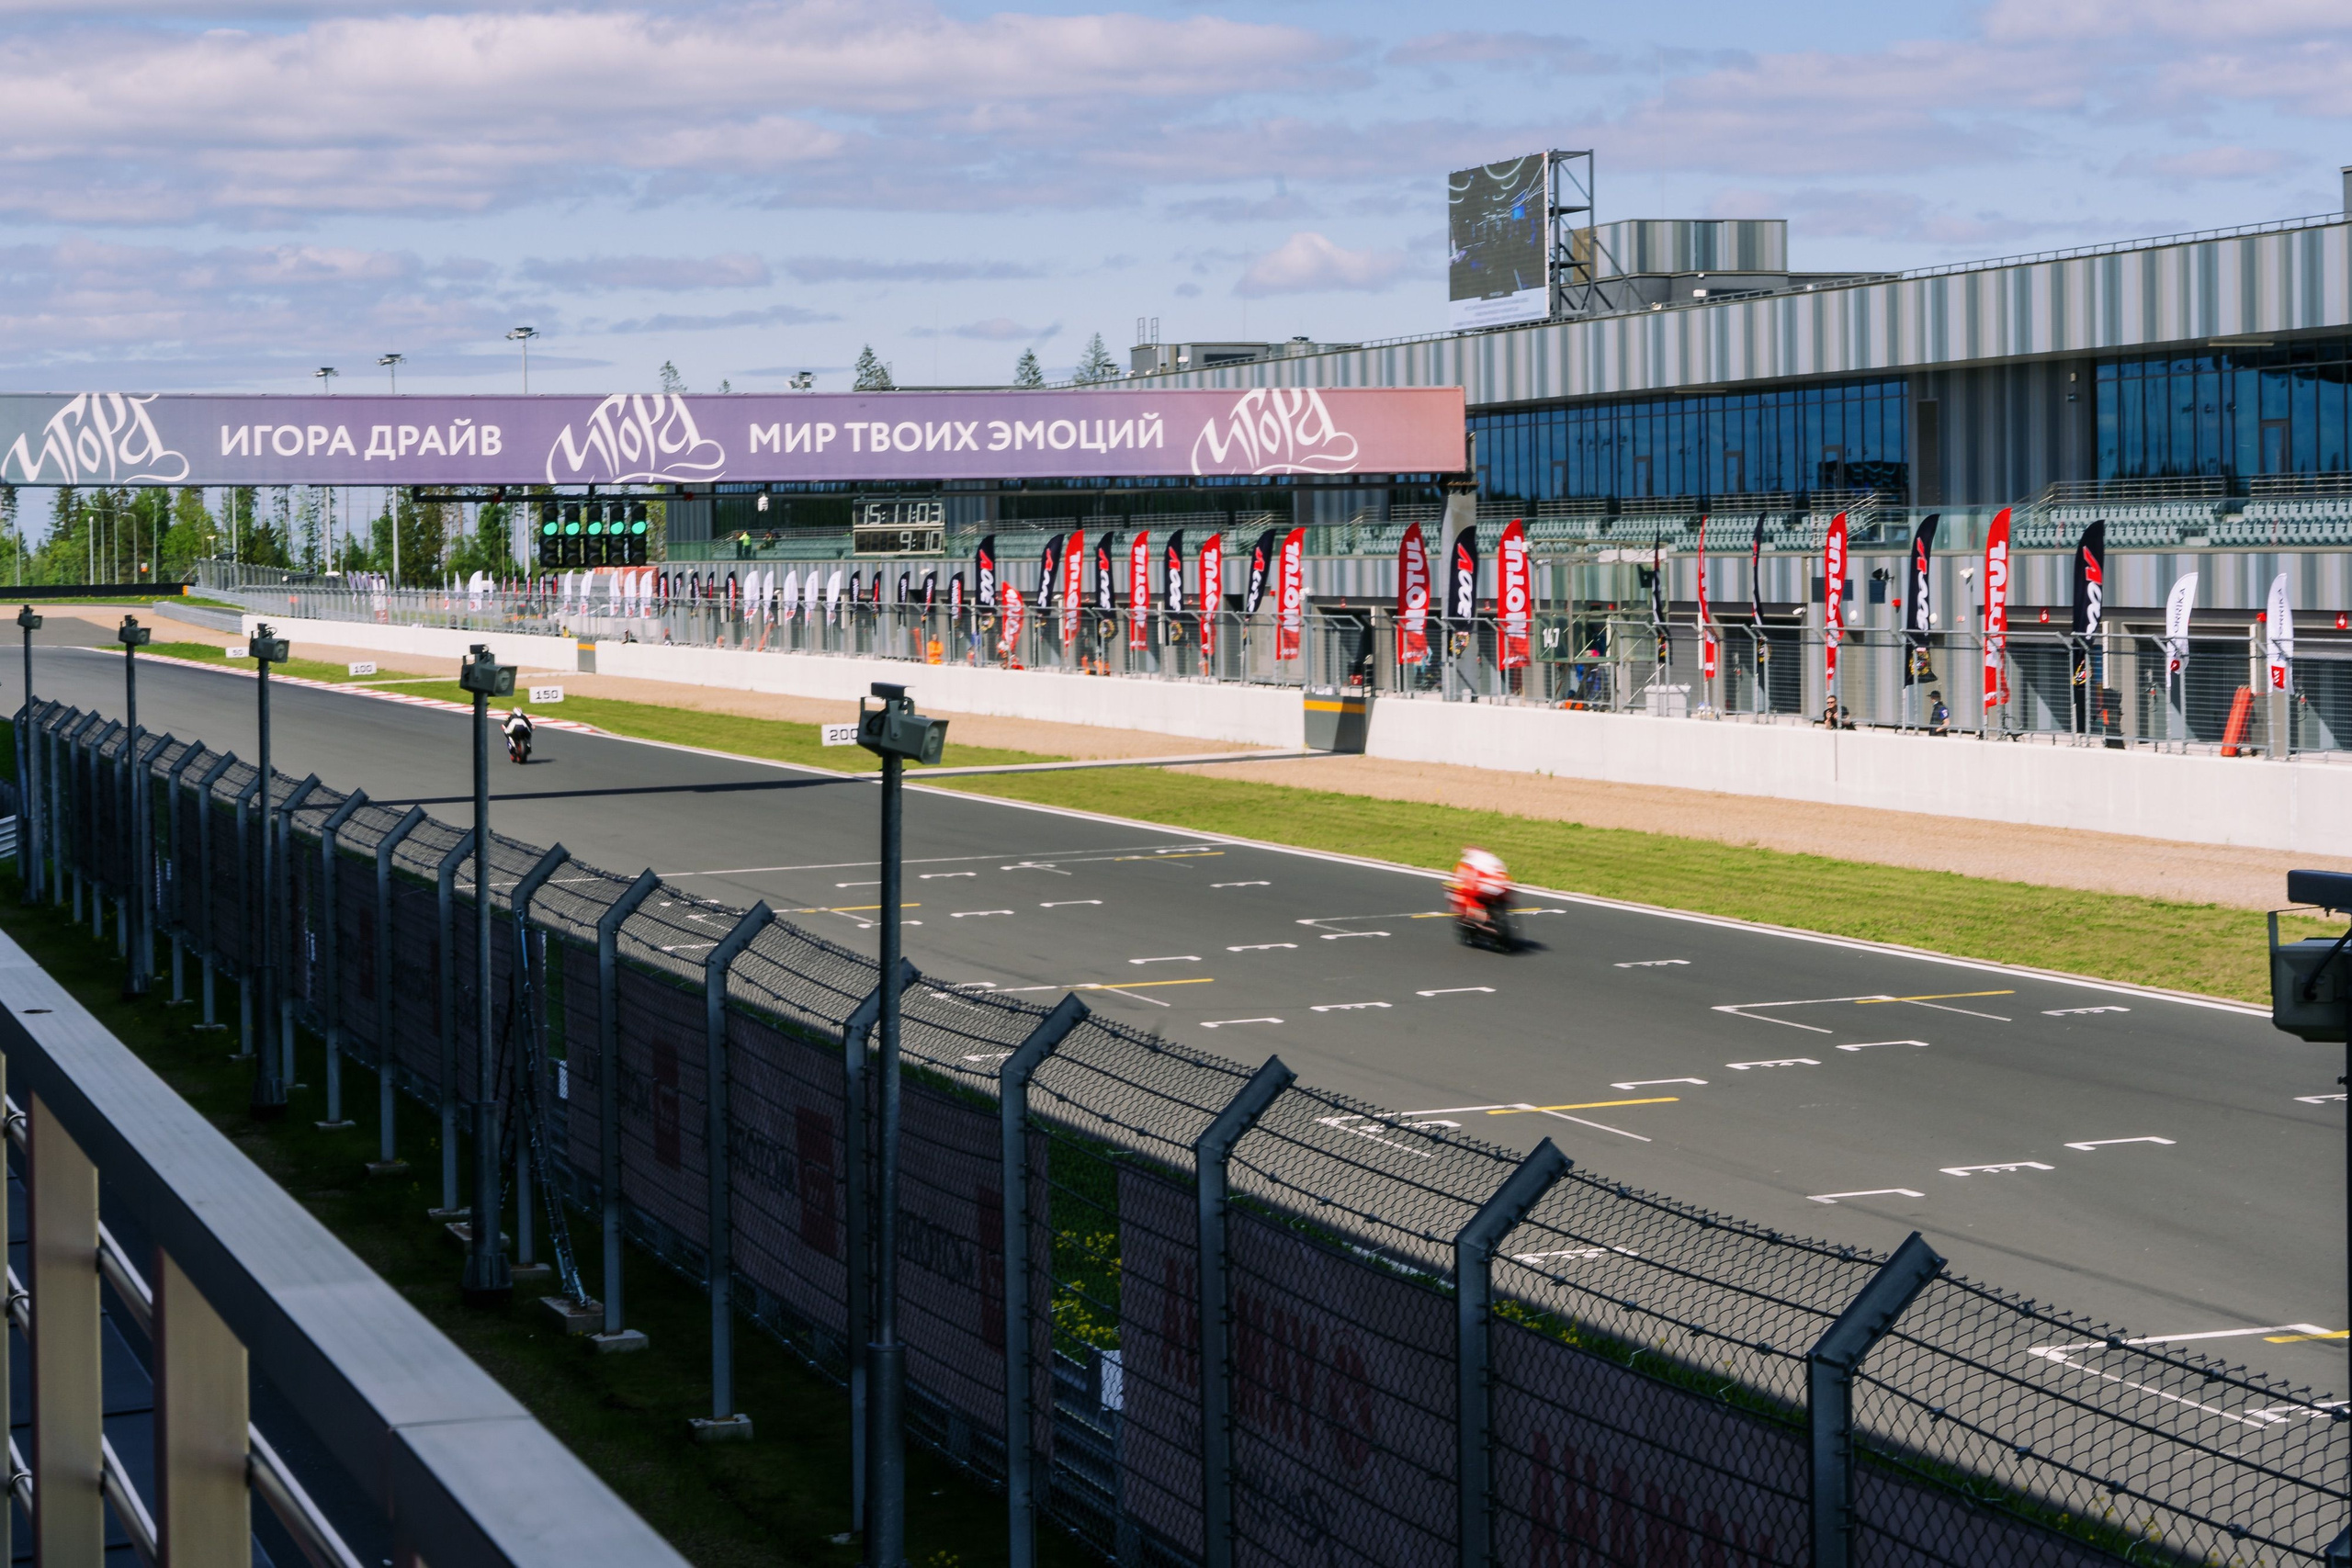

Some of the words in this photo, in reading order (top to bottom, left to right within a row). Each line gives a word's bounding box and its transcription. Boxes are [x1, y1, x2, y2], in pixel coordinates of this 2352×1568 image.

[220, 424, 357, 457] ИГОРА
[364, 418, 503, 461] ДРАЙВ
[750, 423, 836, 453] МИР
[843, 421, 979, 453] ТВОИХ
[987, 412, 1164, 454] ЭМОЦИЙ
[863, 502, 943, 525] 15:11:03
[1134, 544, 1147, 628] MOTUL
[1283, 541, 1301, 633] MOTUL
[1405, 537, 1428, 635] MOTUL
[1457, 543, 1474, 625] 300V
[1504, 536, 1527, 639] MOTUL
[354, 664, 373, 673] 100
[536, 690, 559, 700] 150
[830, 728, 858, 740] 200
